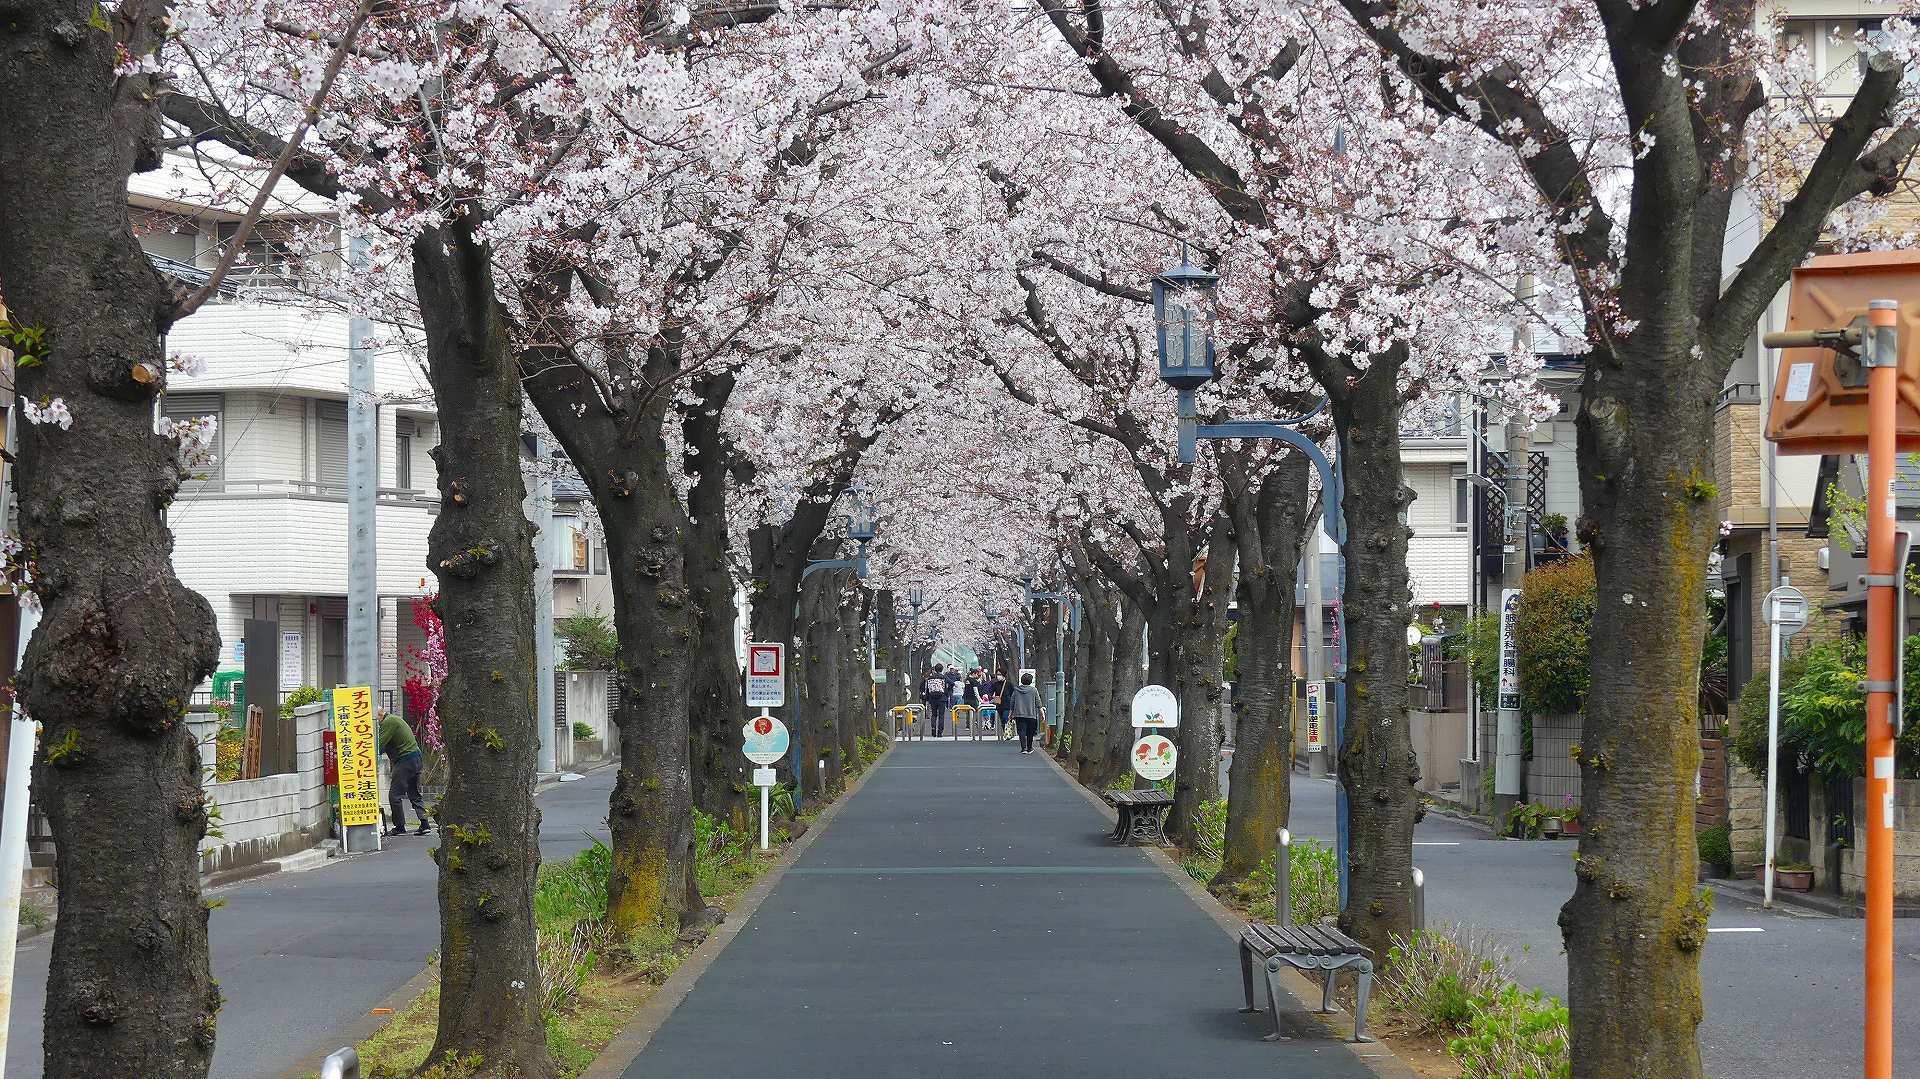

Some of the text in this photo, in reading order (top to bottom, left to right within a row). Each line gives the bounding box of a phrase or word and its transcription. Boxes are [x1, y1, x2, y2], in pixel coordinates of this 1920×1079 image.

[351, 690, 376, 801] チカン・ひったくりに注意
